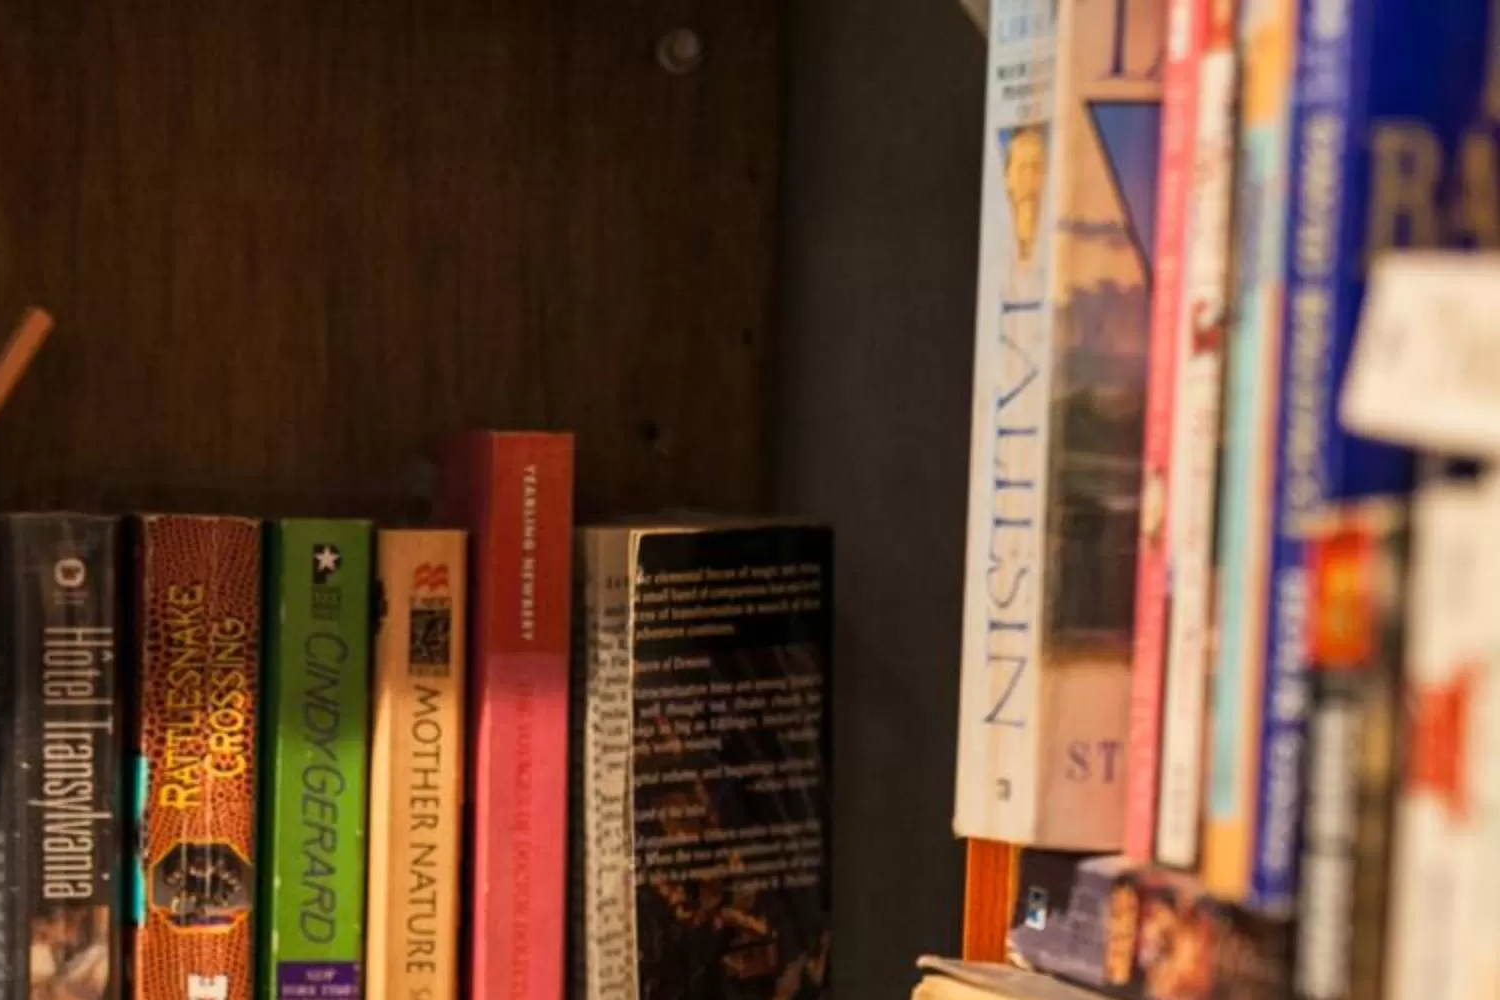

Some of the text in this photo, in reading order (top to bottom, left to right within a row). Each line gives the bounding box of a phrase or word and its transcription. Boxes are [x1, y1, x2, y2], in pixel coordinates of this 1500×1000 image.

[43, 626, 115, 706] Hôtel
[159, 582, 204, 811] RATTLESNAKE
[201, 617, 247, 780] CROSSING
[305, 633, 349, 758] CINDY
[29, 719, 115, 900] Transylvania
[300, 766, 345, 946] GERARD
[405, 684, 443, 975] MOTHER NATURE
